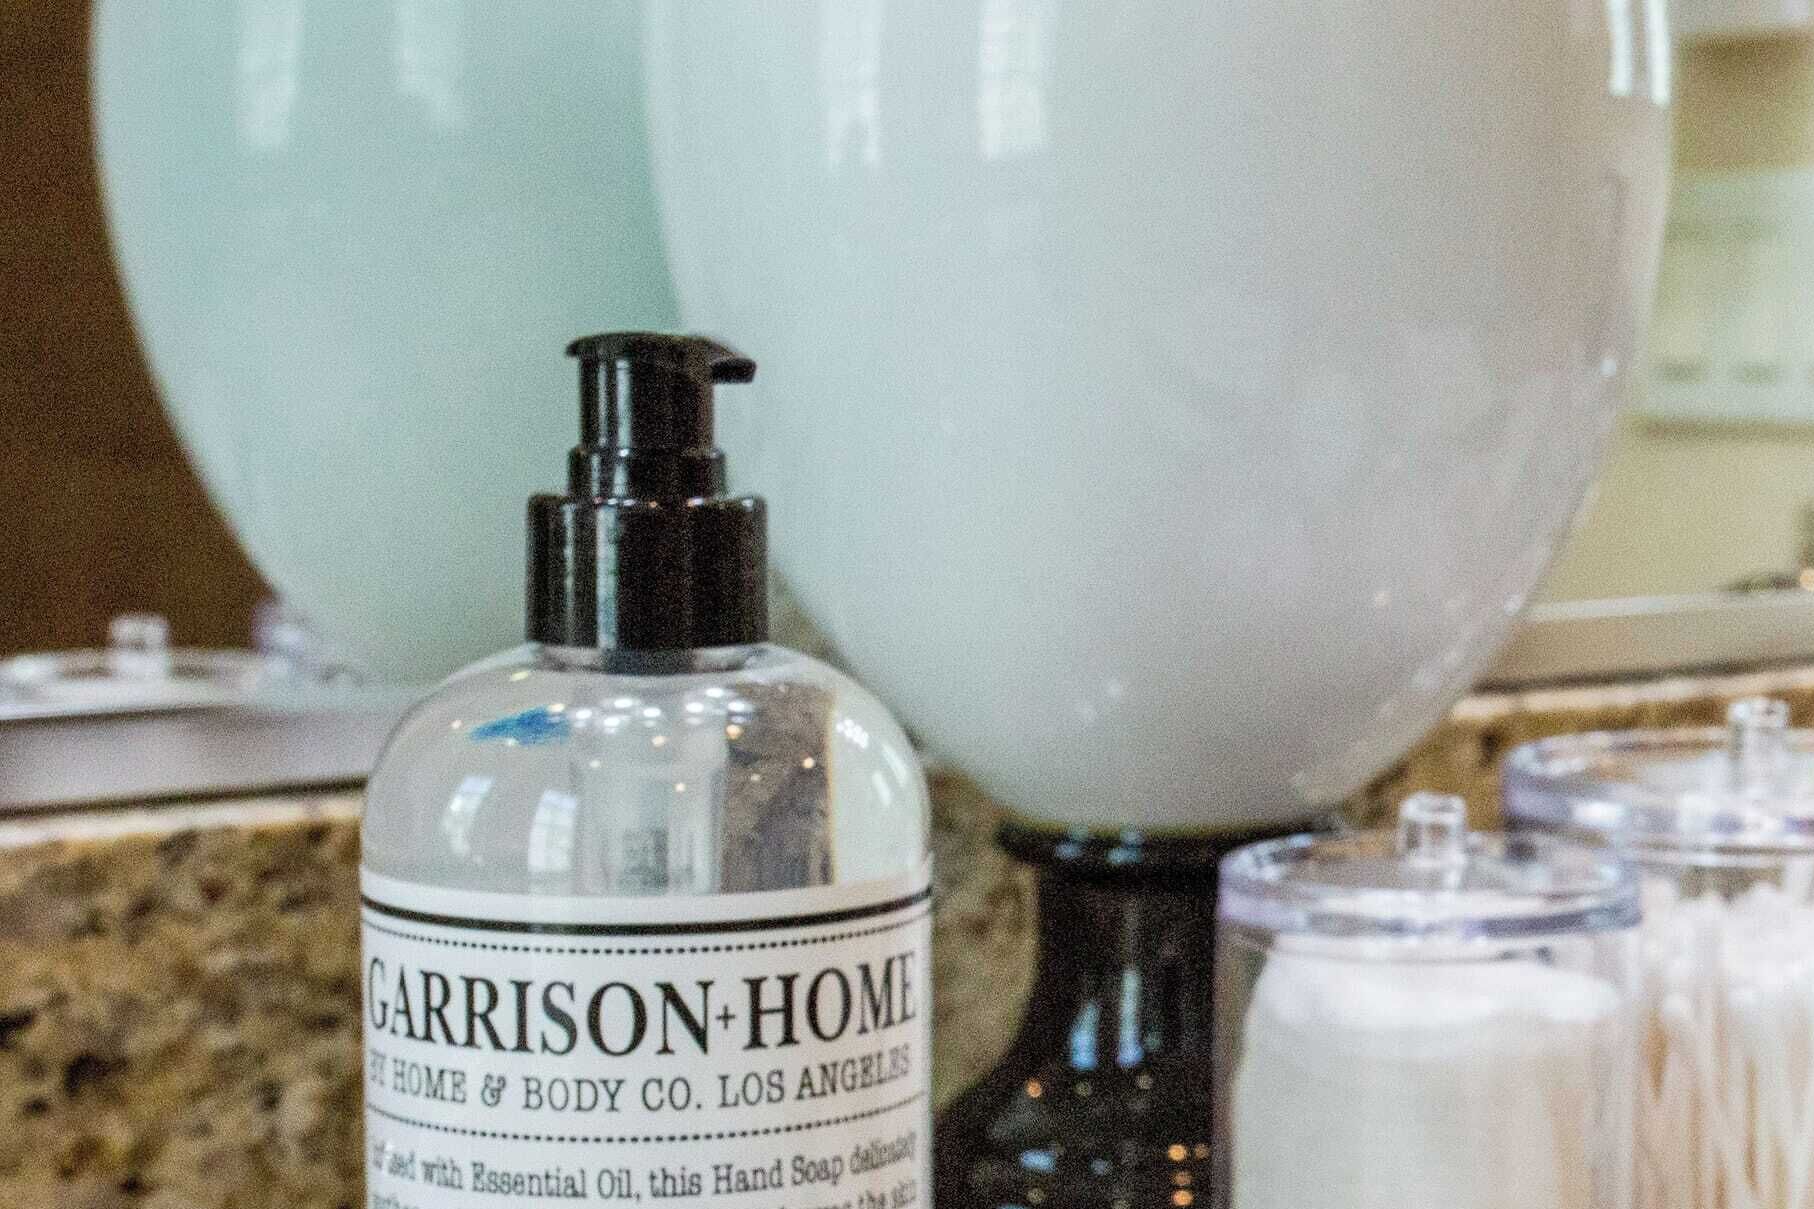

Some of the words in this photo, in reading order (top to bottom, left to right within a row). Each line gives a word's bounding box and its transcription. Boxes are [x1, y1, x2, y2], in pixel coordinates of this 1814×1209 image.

[393, 1058, 467, 1104] HOME
[481, 1073, 507, 1108] &
[522, 1076, 625, 1113] BODY
[642, 1077, 702, 1112] CO.
[718, 1069, 785, 1109] LOS
[796, 1043, 910, 1101] ANGELES
[422, 1157, 463, 1191] with
[472, 1162, 588, 1200] Essential
[597, 1168, 641, 1202] Oil,
[650, 1166, 702, 1199] this
[713, 1158, 784, 1196] Hand
[791, 1153, 845, 1187] Soap
